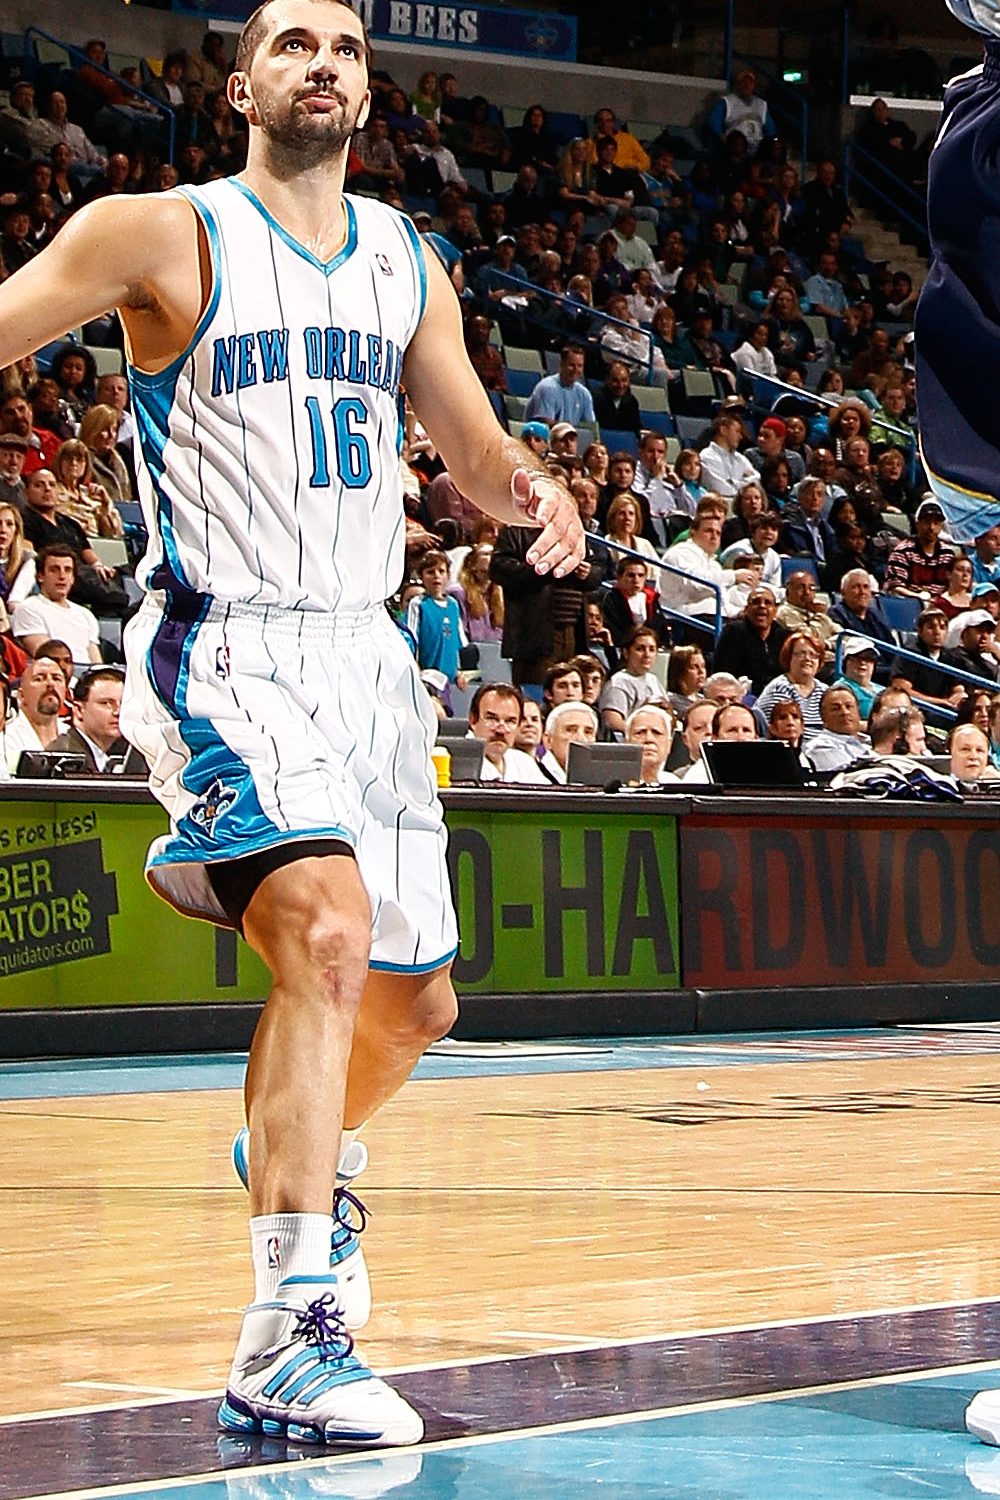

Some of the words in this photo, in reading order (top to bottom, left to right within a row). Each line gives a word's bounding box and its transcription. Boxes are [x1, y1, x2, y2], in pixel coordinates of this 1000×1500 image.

[388, 0, 479, 44] BEES
[211, 328, 290, 397] NEW
[305, 395, 373, 489] 16
[16, 823, 47, 846] FOR
[53, 810, 97, 840] LESS!
